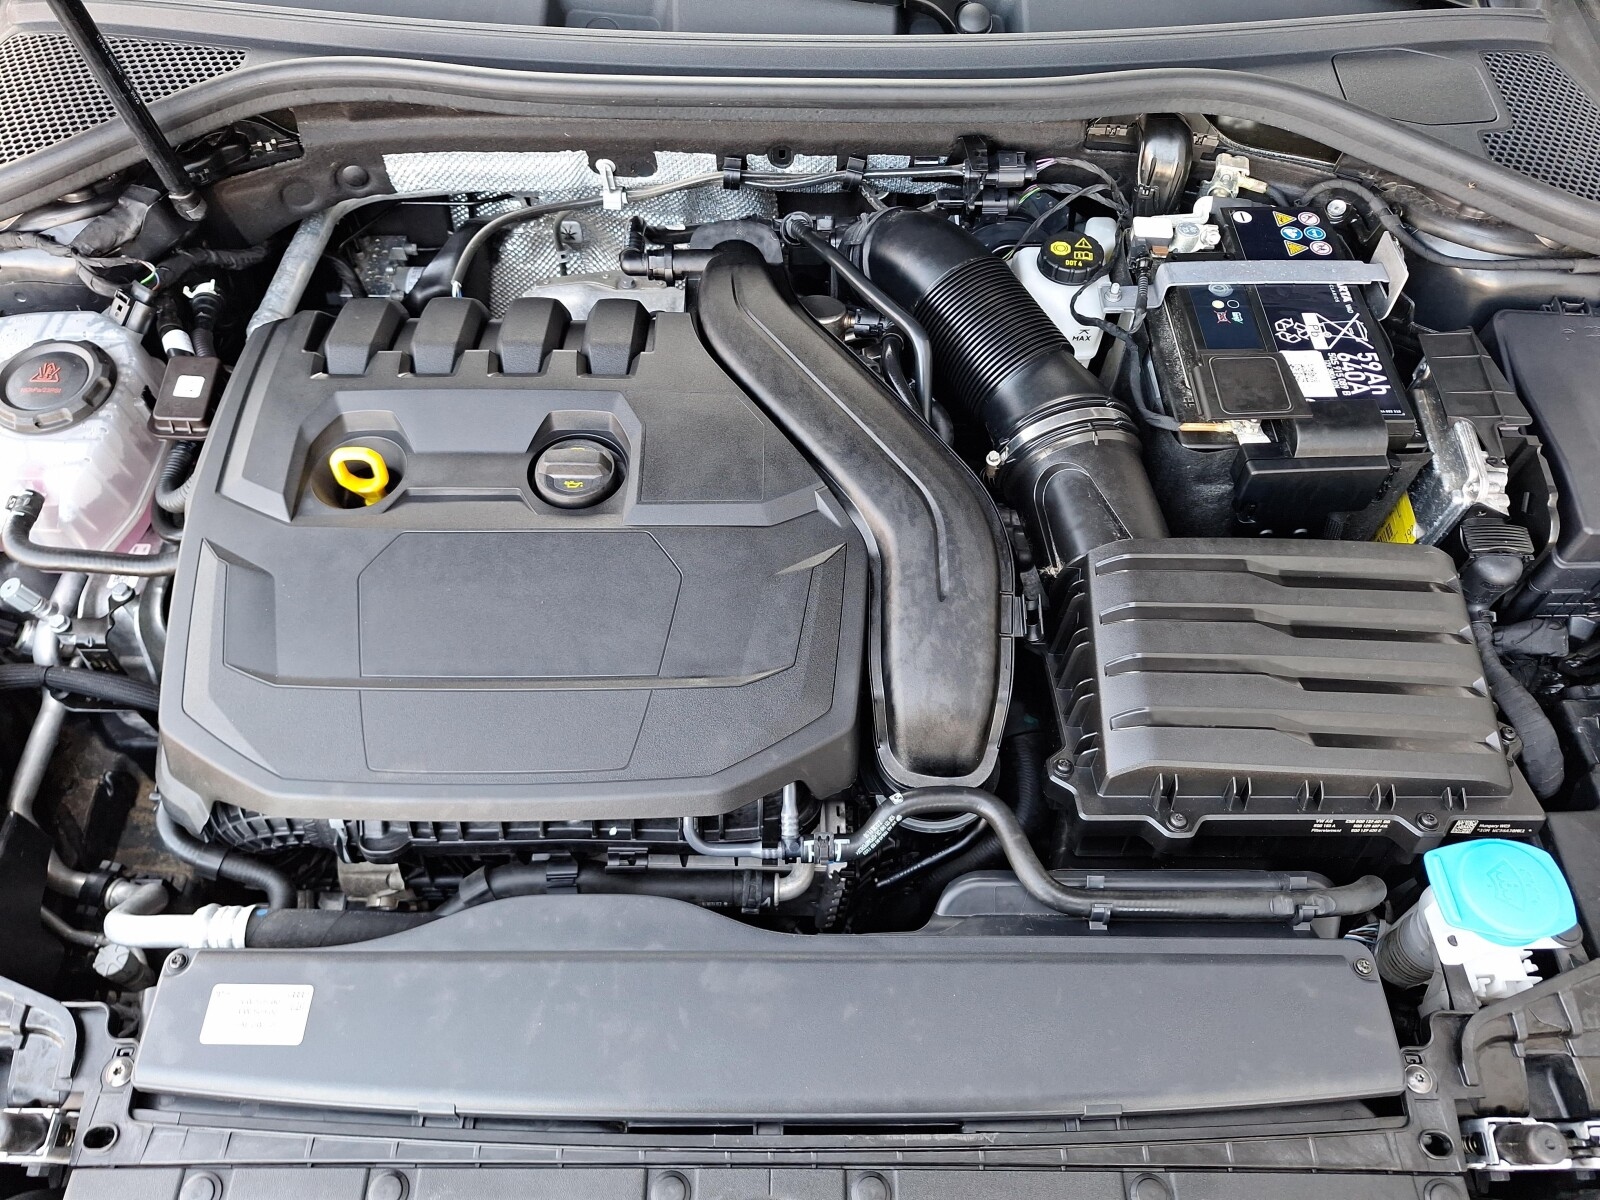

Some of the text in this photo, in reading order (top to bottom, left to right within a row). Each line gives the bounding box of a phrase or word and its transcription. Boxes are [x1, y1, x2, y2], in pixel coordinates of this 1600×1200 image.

[1065, 259, 1078, 267] DOT
[1337, 352, 1370, 395] 640A
[1357, 352, 1391, 395] 59Ah
